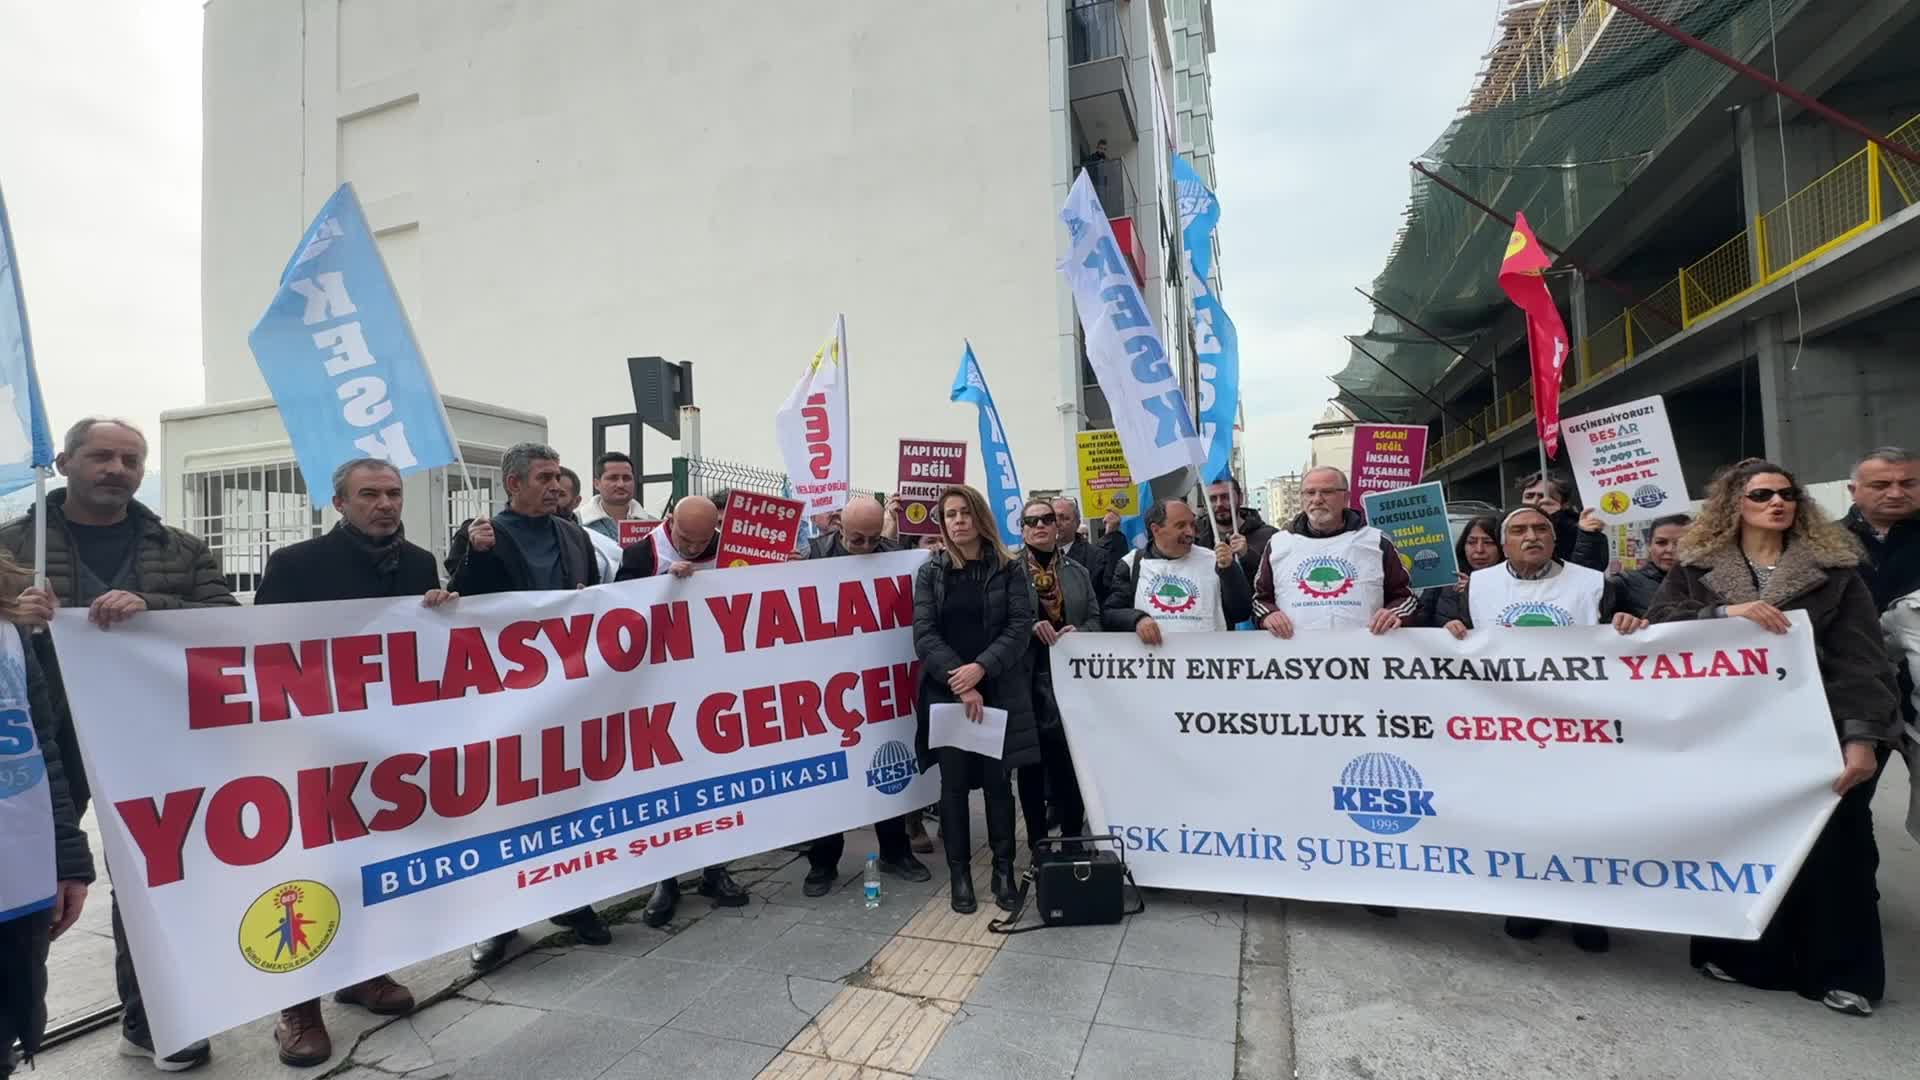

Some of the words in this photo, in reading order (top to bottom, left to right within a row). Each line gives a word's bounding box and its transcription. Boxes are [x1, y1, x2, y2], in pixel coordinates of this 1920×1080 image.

[1569, 405, 1655, 433] GEÇİNEMİYORUZ!
[1373, 429, 1408, 440] ASGARİ
[1589, 422, 1639, 443] BESAR
[903, 445, 931, 457] KAPI
[933, 446, 963, 458] KULU
[1375, 440, 1403, 451] DEĞİL
[1366, 451, 1410, 464] İNSANCA
[911, 460, 953, 478] DEĞİL
[1362, 466, 1411, 478] YAŞAMAK
[733, 495, 797, 520] Birleşe
[1379, 493, 1428, 512] SEFALETE
[1632, 491, 1668, 506] KESK
[1371, 506, 1441, 526] YOKSULLUĞA
[731, 519, 788, 545] Birleşe
[1392, 524, 1425, 538] TESLİM
[723, 543, 789, 562] KAZANACAĞIZ!
[185, 600, 695, 731] ENFLASYON
[705, 574, 913, 653] YALAN
[1186, 656, 1371, 681] ENFLASYON
[1383, 655, 1609, 682] RAKAMLARI
[1175, 711, 1366, 738] YOKSULLUK
[1377, 709, 1434, 739] İSE
[1447, 716, 1625, 749] GERÇEK!
[115, 702, 683, 888] YOKSULLUK
[697, 659, 920, 754] GERÇEK
[865, 757, 918, 787] KESK
[1333, 786, 1437, 817] KESK
[381, 848, 480, 896] BÜRO
[499, 790, 682, 861] EMEKÇİLERİ
[696, 760, 839, 808] SENDİKASI
[1369, 818, 1400, 831] 1995
[517, 845, 616, 889] İZMİR
[629, 810, 745, 856] ŞUBESİ
[1179, 823, 1286, 861] İZMİR
[1297, 836, 1474, 876] ŞUBELER
